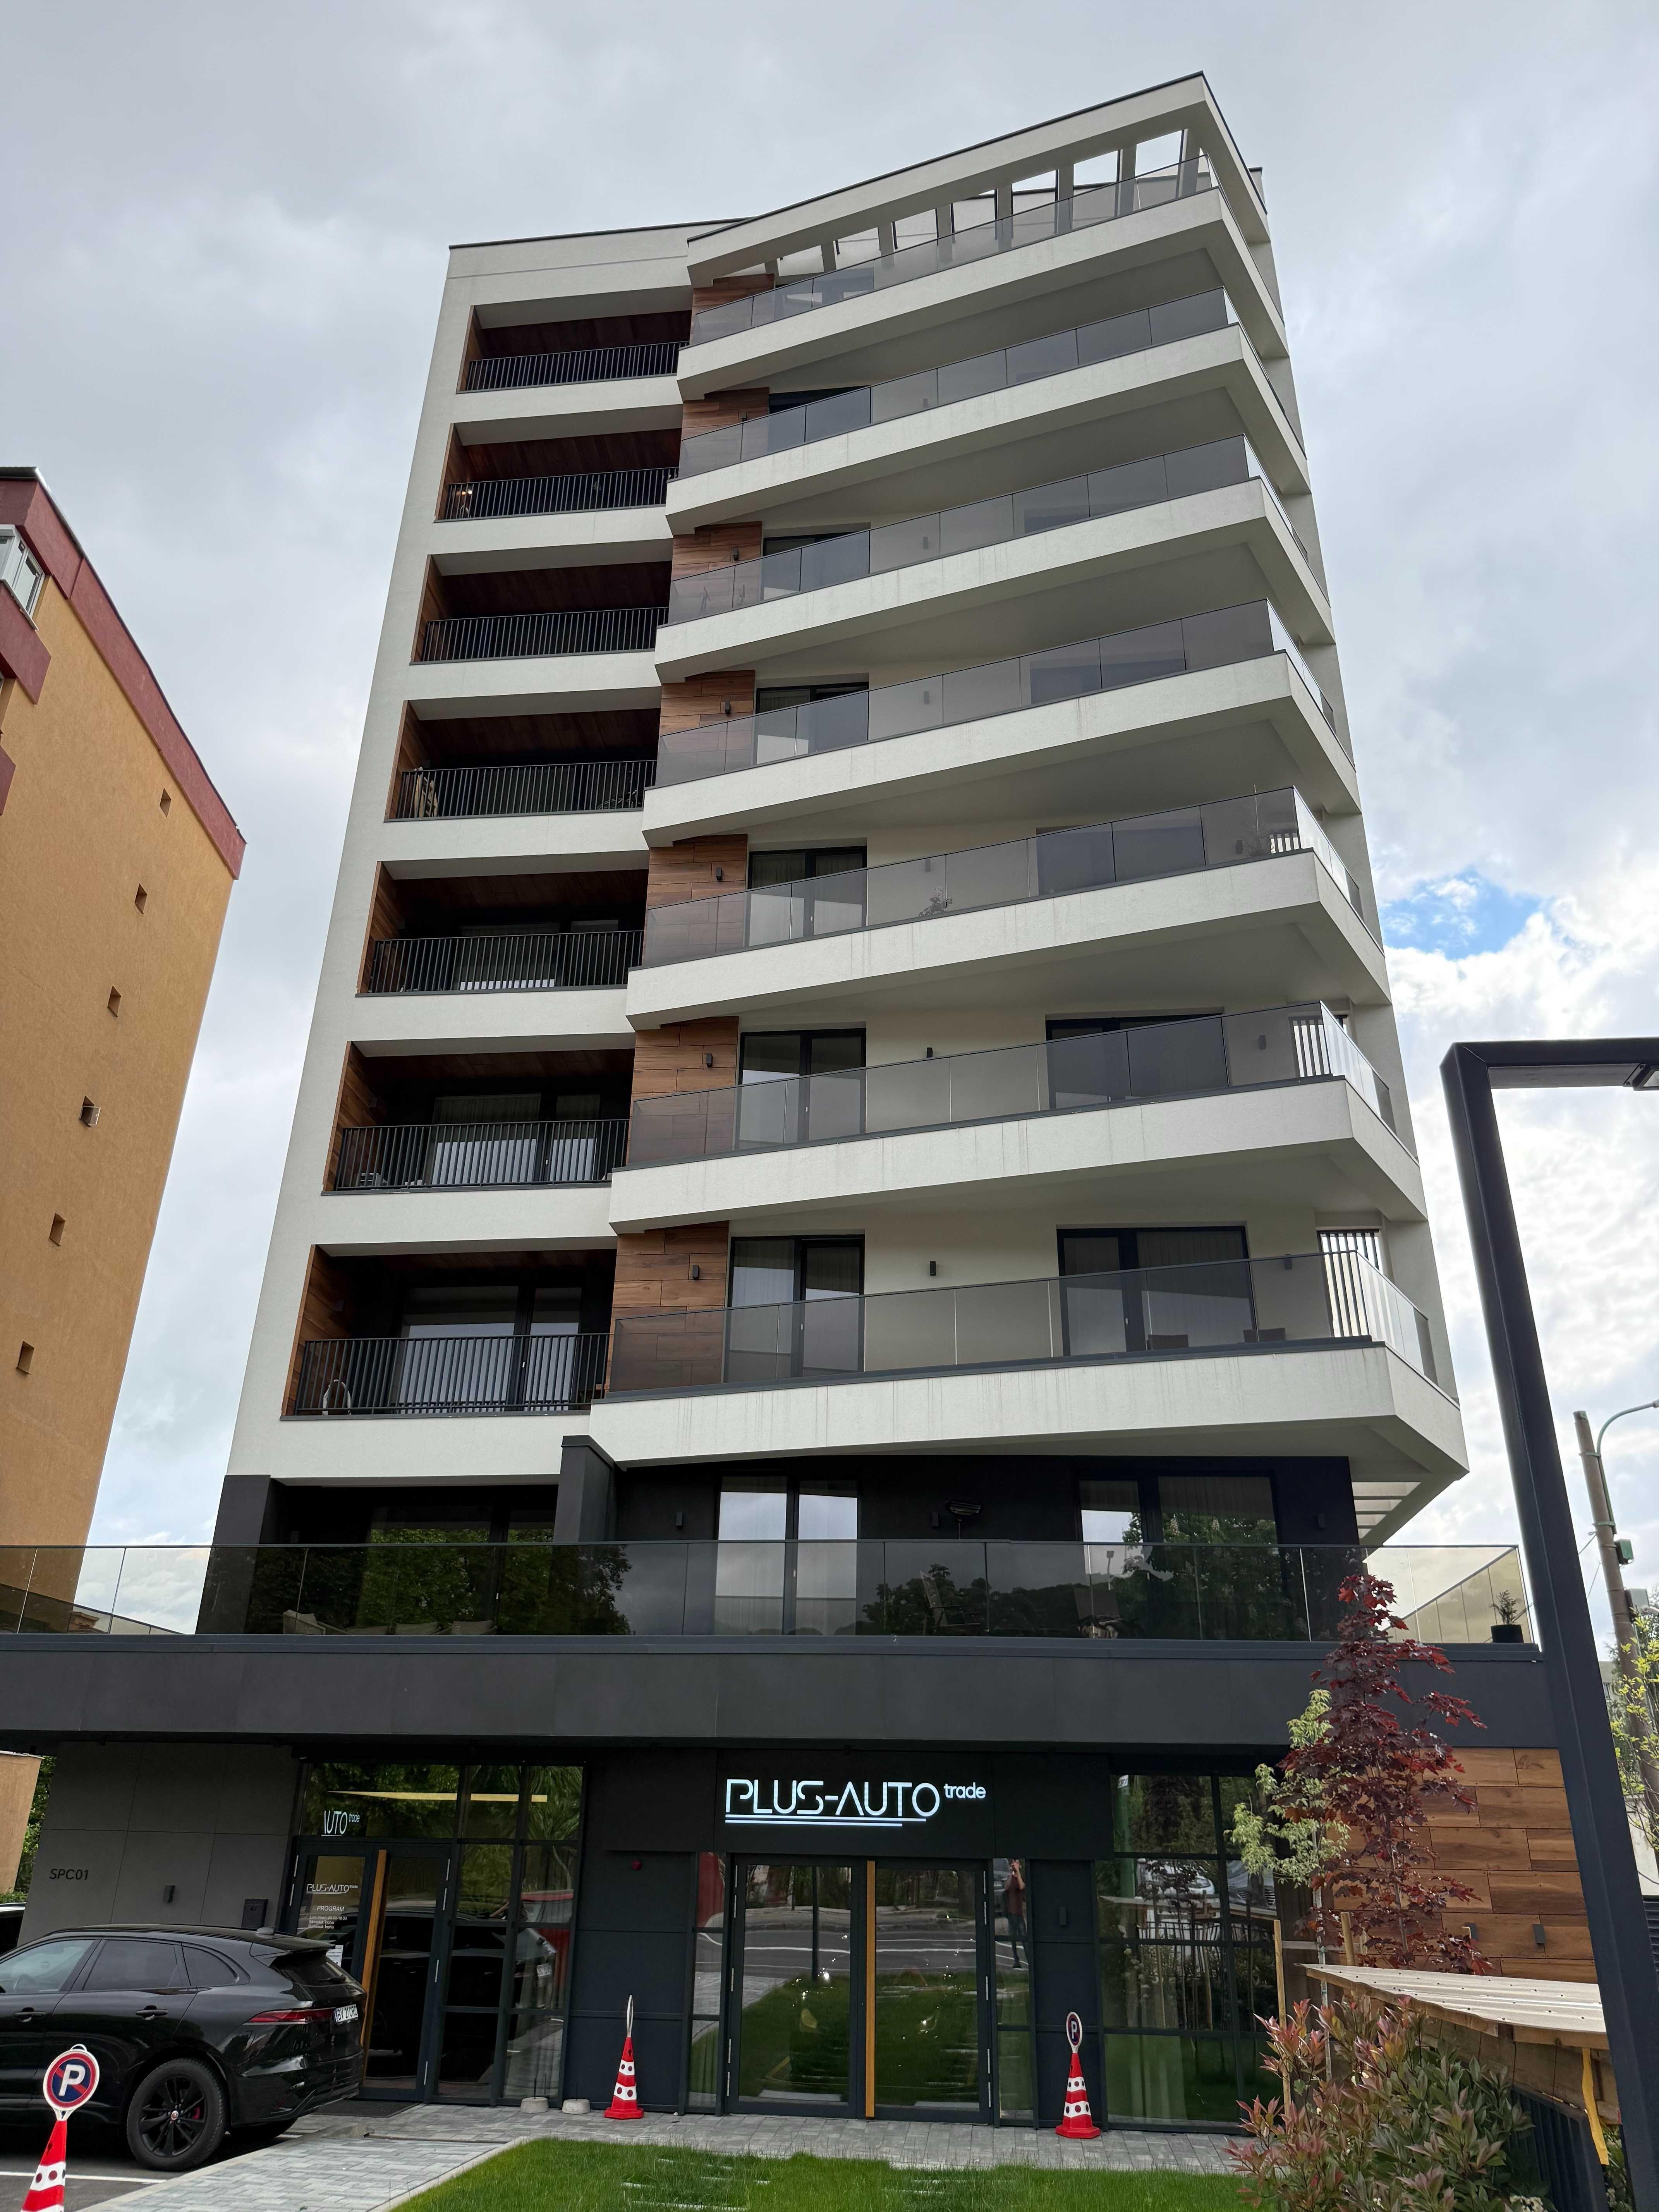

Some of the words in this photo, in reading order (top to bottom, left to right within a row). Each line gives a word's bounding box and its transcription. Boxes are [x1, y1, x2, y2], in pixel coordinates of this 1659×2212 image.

[725, 1779, 940, 1817] PLUS-AUTO
[943, 1782, 986, 1799] trade
[50, 1869, 89, 1881] SPC01
[307, 1884, 350, 1892] PLUS-AUTO
[1071, 2020, 1077, 2039] P
[59, 2064, 86, 2096] P
